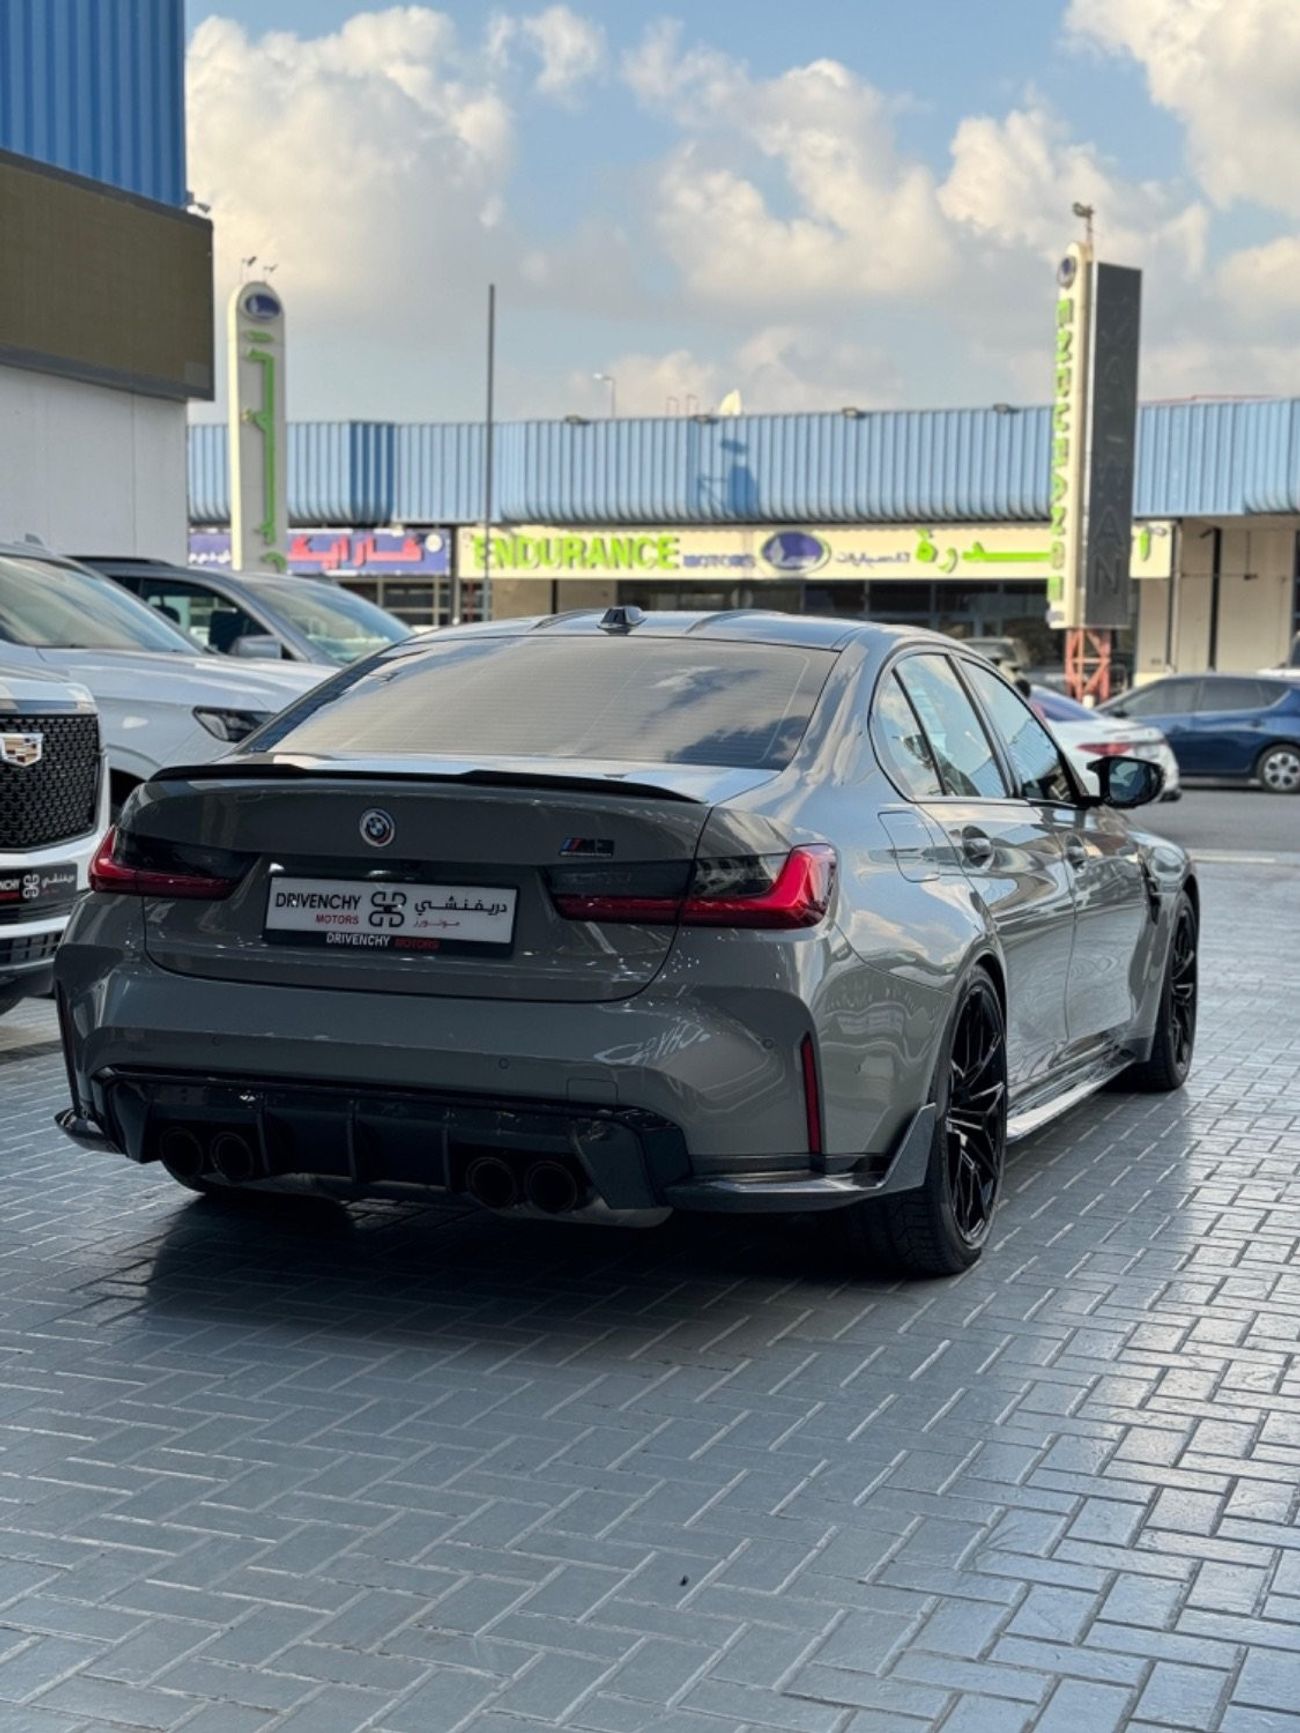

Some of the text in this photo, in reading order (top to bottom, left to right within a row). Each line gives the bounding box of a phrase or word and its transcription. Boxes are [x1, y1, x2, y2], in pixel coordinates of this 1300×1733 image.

[471, 531, 681, 572] ENDURANCE
[274, 891, 363, 910] DRIVENCHY
[413, 896, 508, 917] دريفنشي
[315, 913, 360, 925] MOTORS
[326, 932, 441, 950] DRIVENCHY MOTORS
